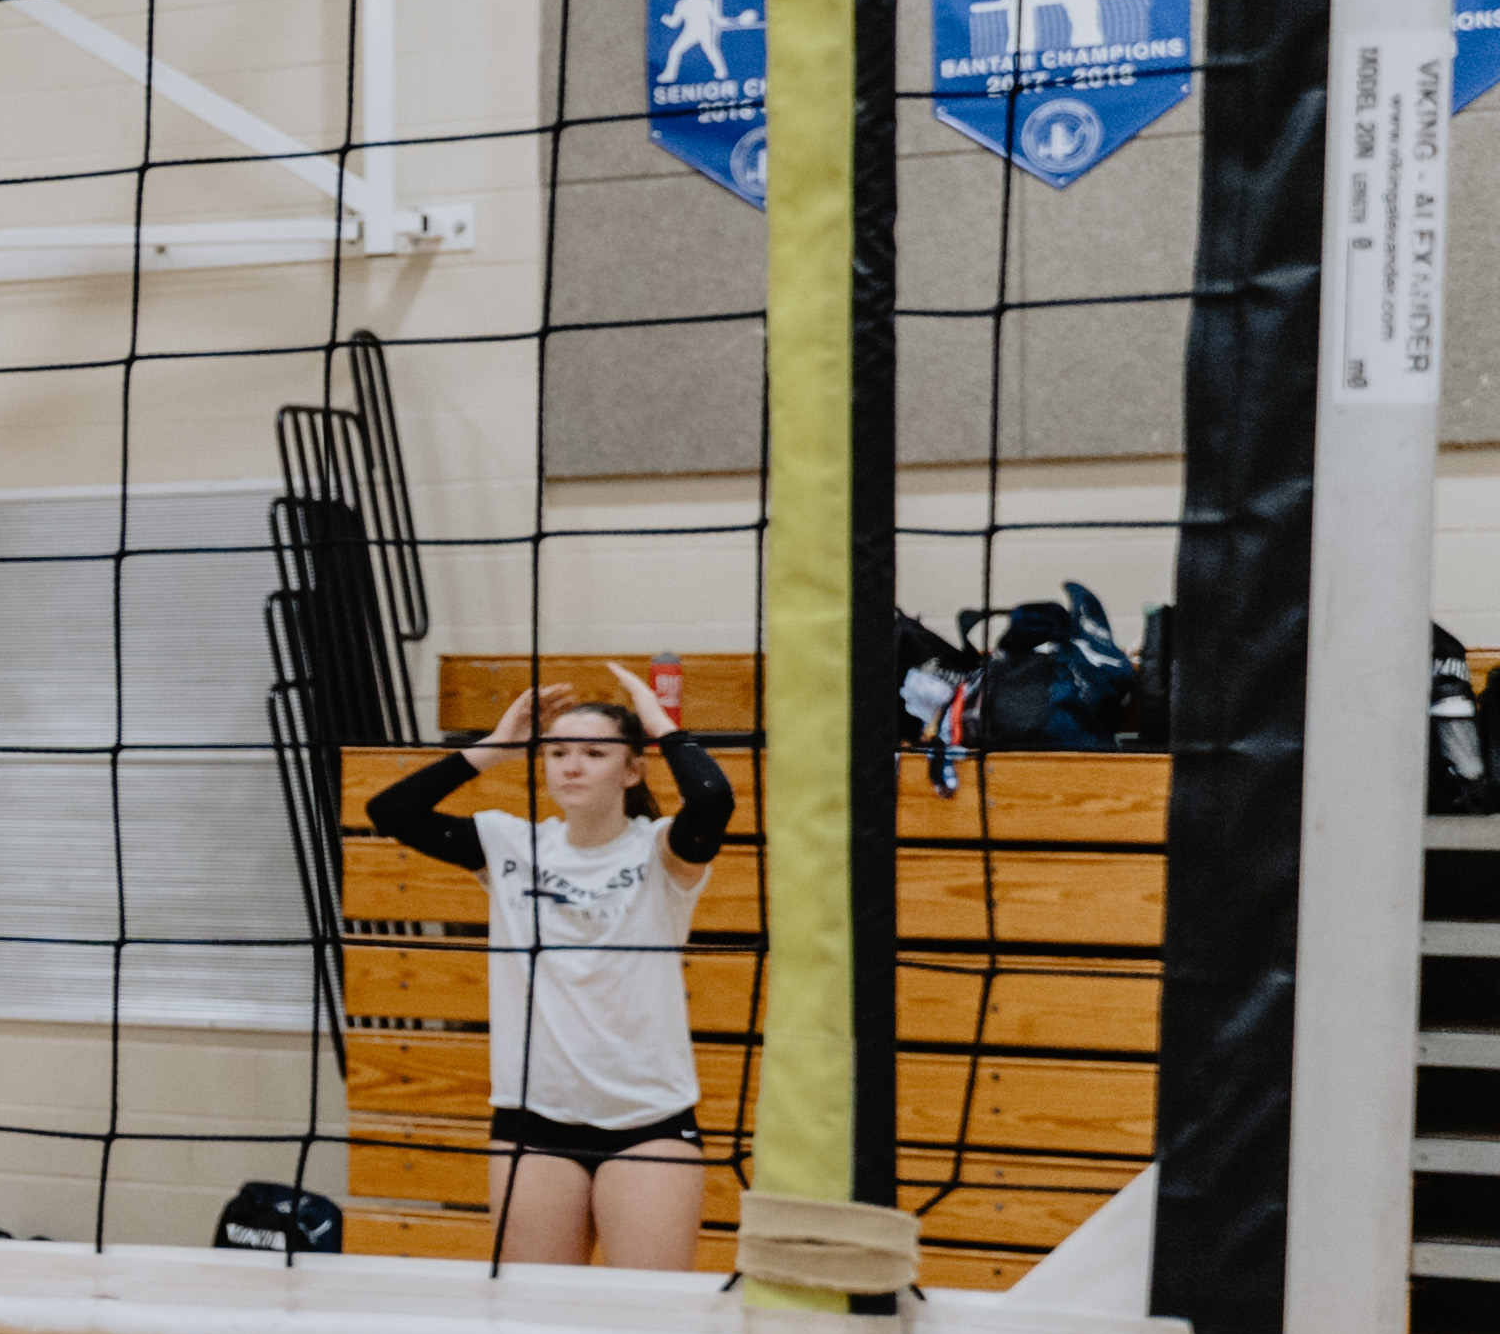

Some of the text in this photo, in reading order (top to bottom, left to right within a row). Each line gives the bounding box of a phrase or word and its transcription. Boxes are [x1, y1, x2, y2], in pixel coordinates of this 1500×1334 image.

[1041, 38, 1186, 69] CHAMPIONS
[653, 81, 739, 105] SENIOR
[1413, 59, 1441, 161] VIKING
